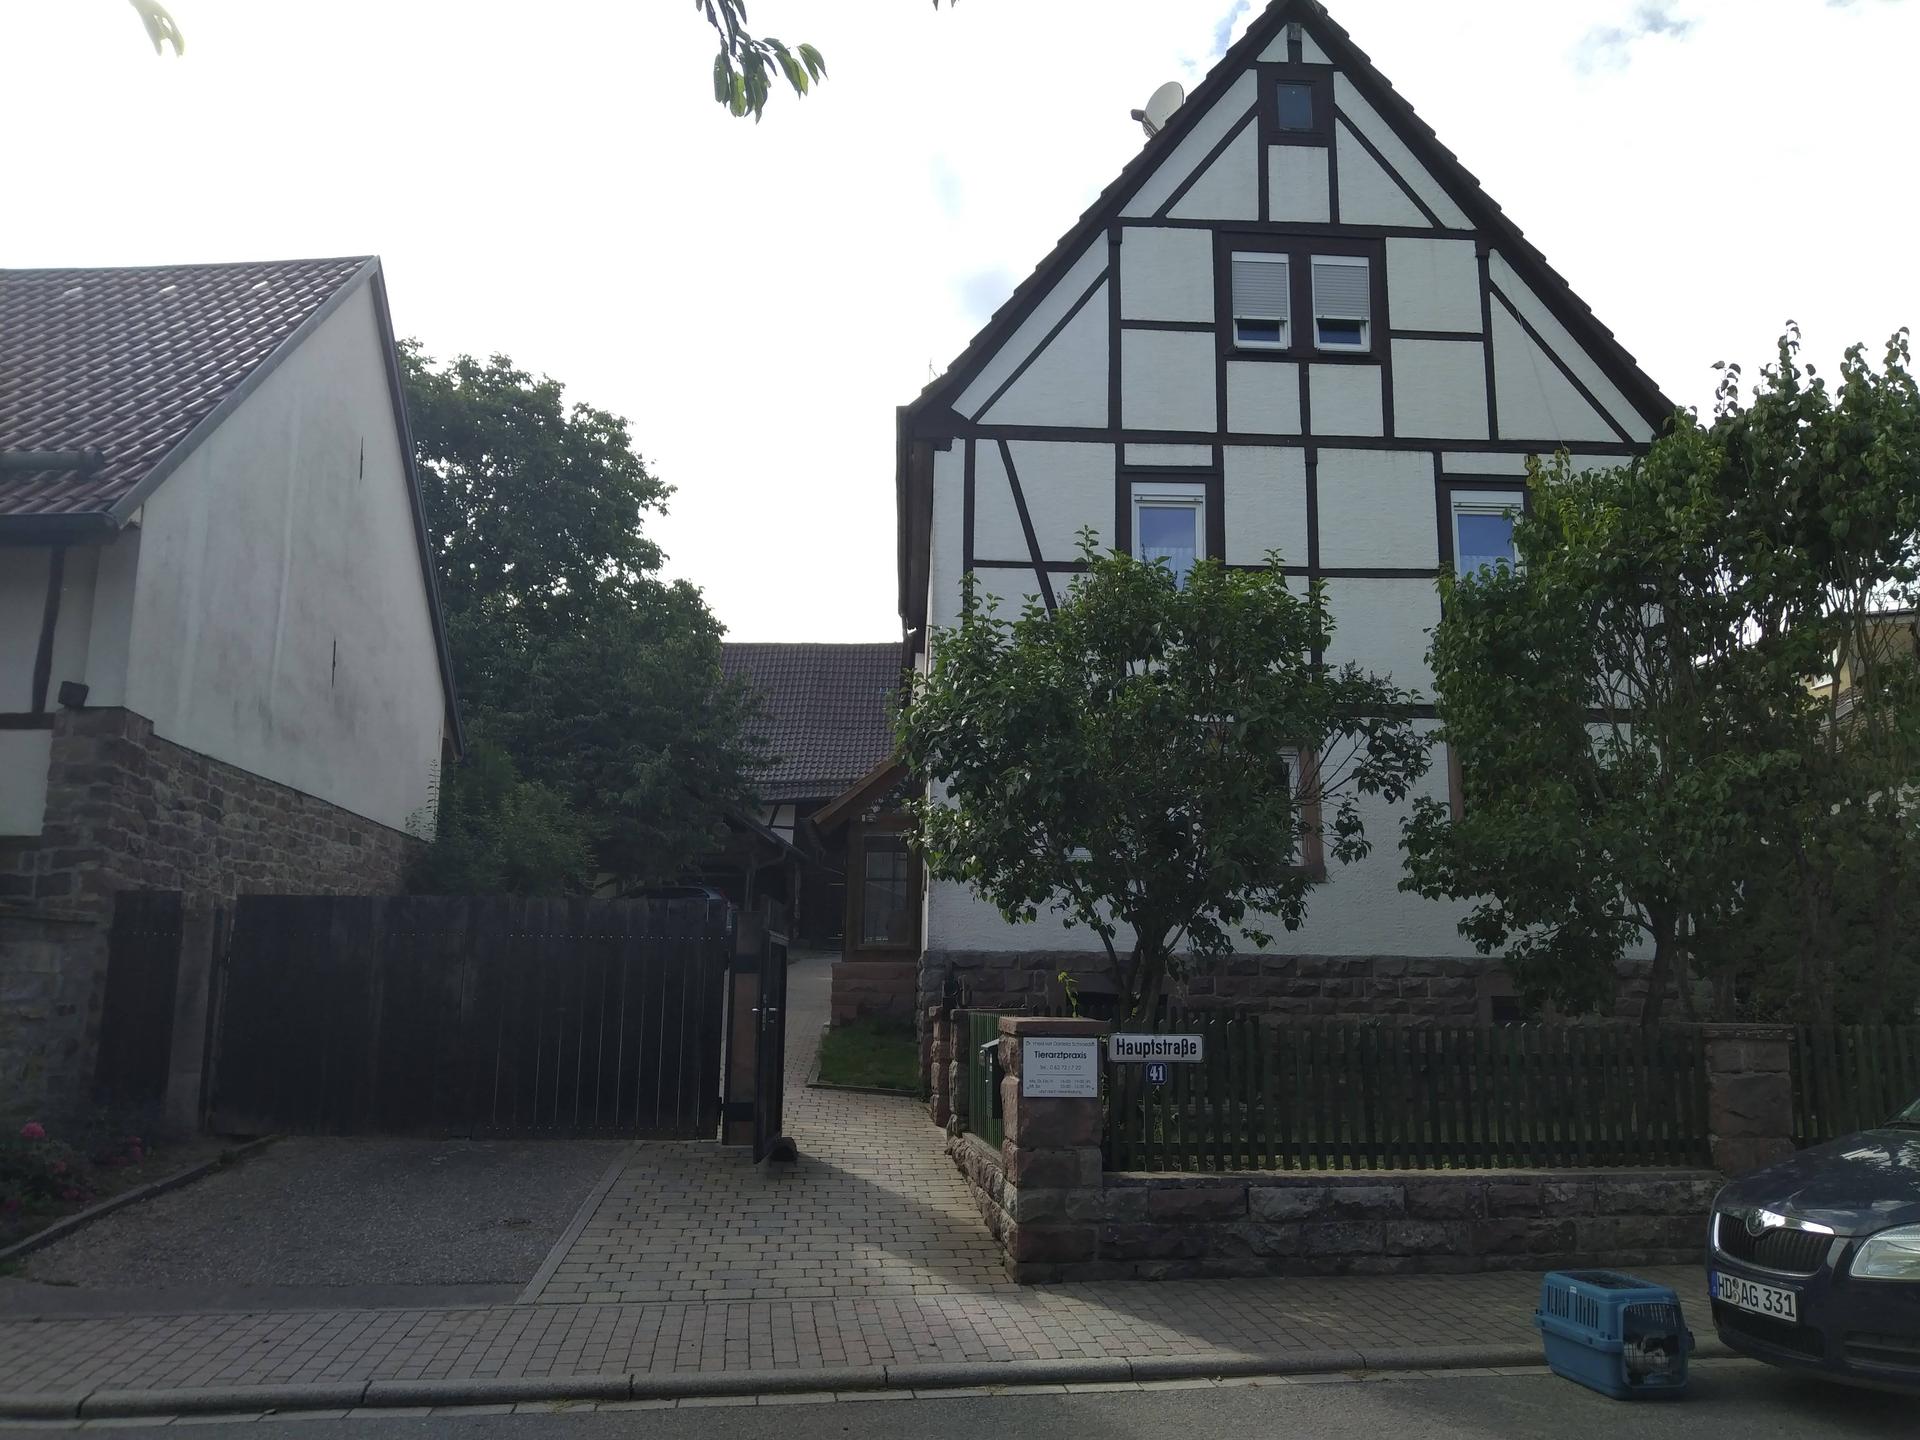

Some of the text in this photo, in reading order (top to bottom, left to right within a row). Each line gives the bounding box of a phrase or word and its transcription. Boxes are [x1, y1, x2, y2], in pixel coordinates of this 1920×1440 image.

[1034, 1051, 1087, 1060] Tierarztpraxis
[1116, 1038, 1197, 1058] Hauptstraße
[1149, 1065, 1164, 1080] 41
[1718, 1275, 1795, 1318] HD AG 331
